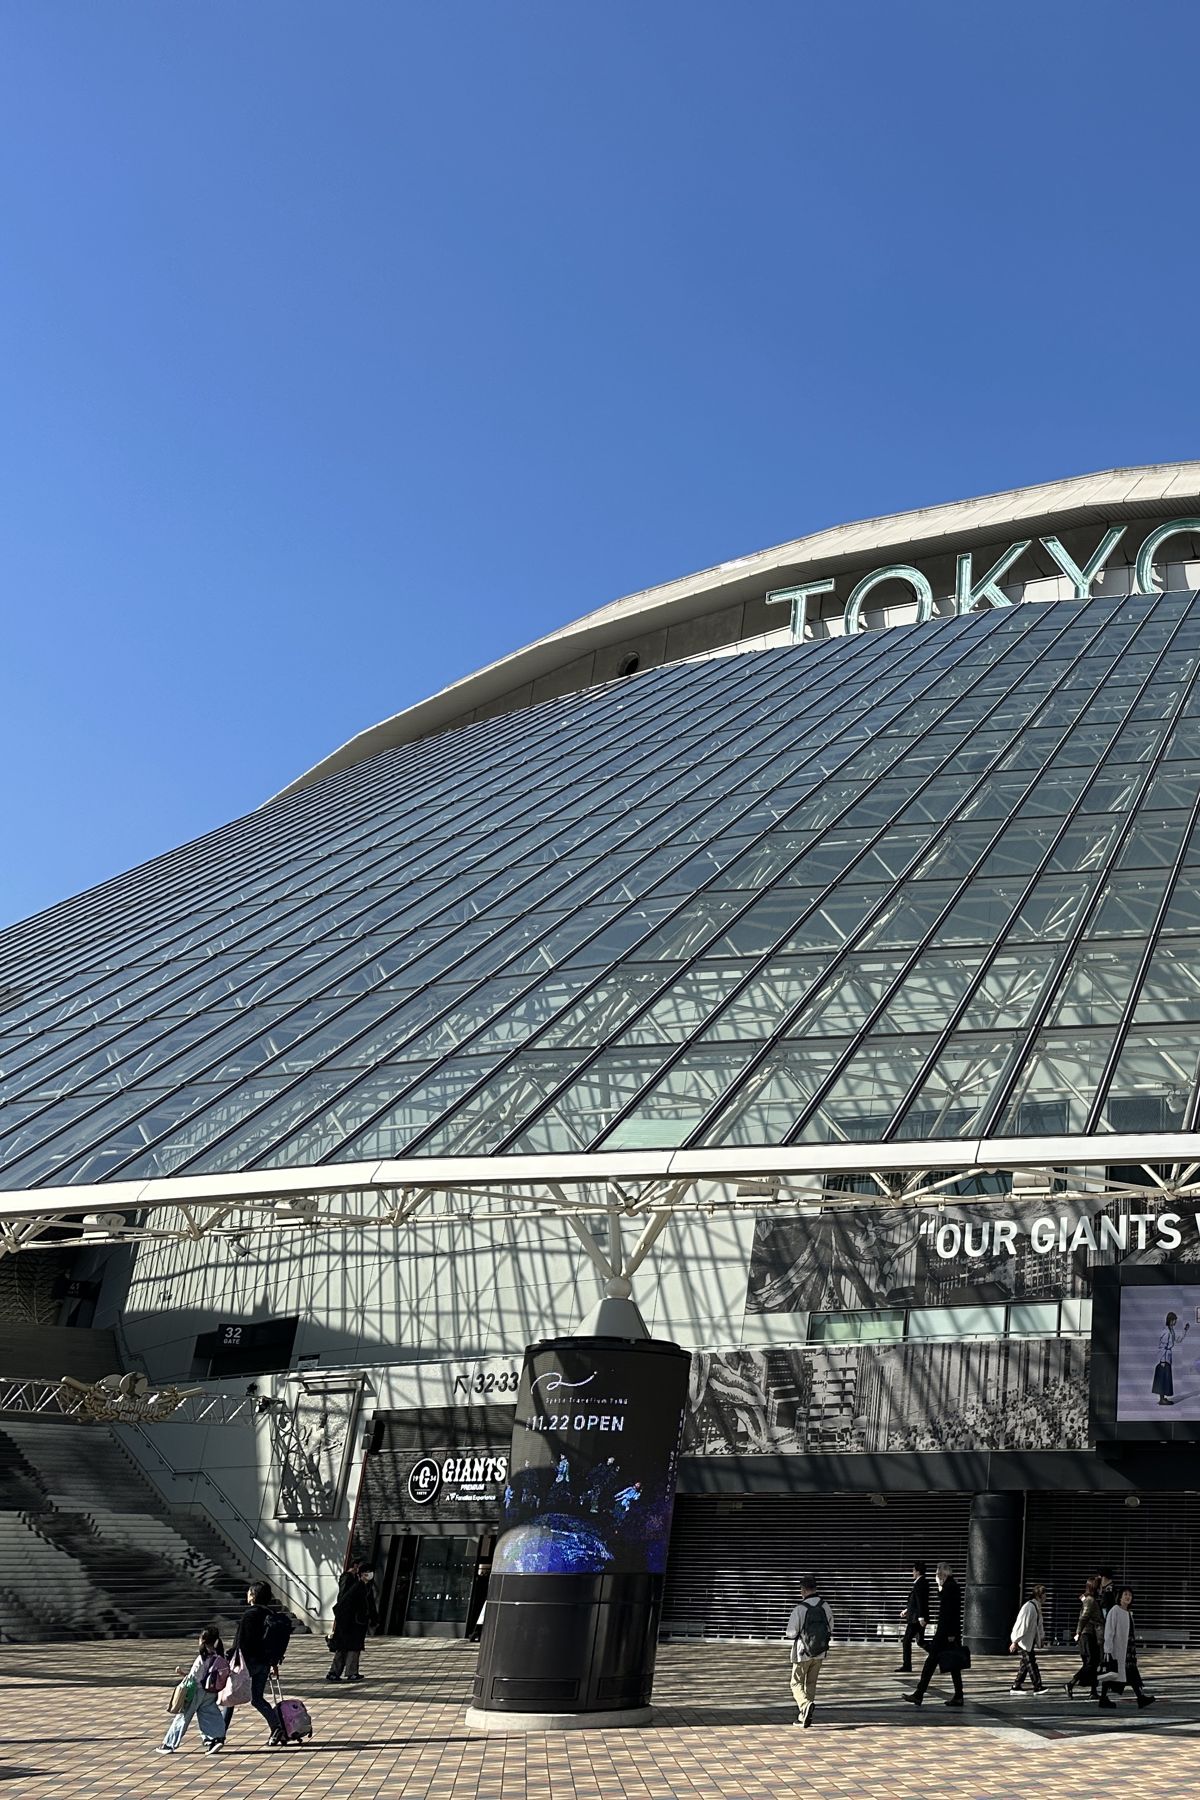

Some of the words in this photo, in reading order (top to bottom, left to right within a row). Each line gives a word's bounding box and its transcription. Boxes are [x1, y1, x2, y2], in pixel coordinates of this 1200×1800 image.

[1031, 1213, 1182, 1252] GIANTS
[225, 1327, 242, 1338] 32
[532, 1414, 570, 1431] 11.22
[573, 1414, 625, 1432] OPEN
[441, 1456, 508, 1483] GIANTS
